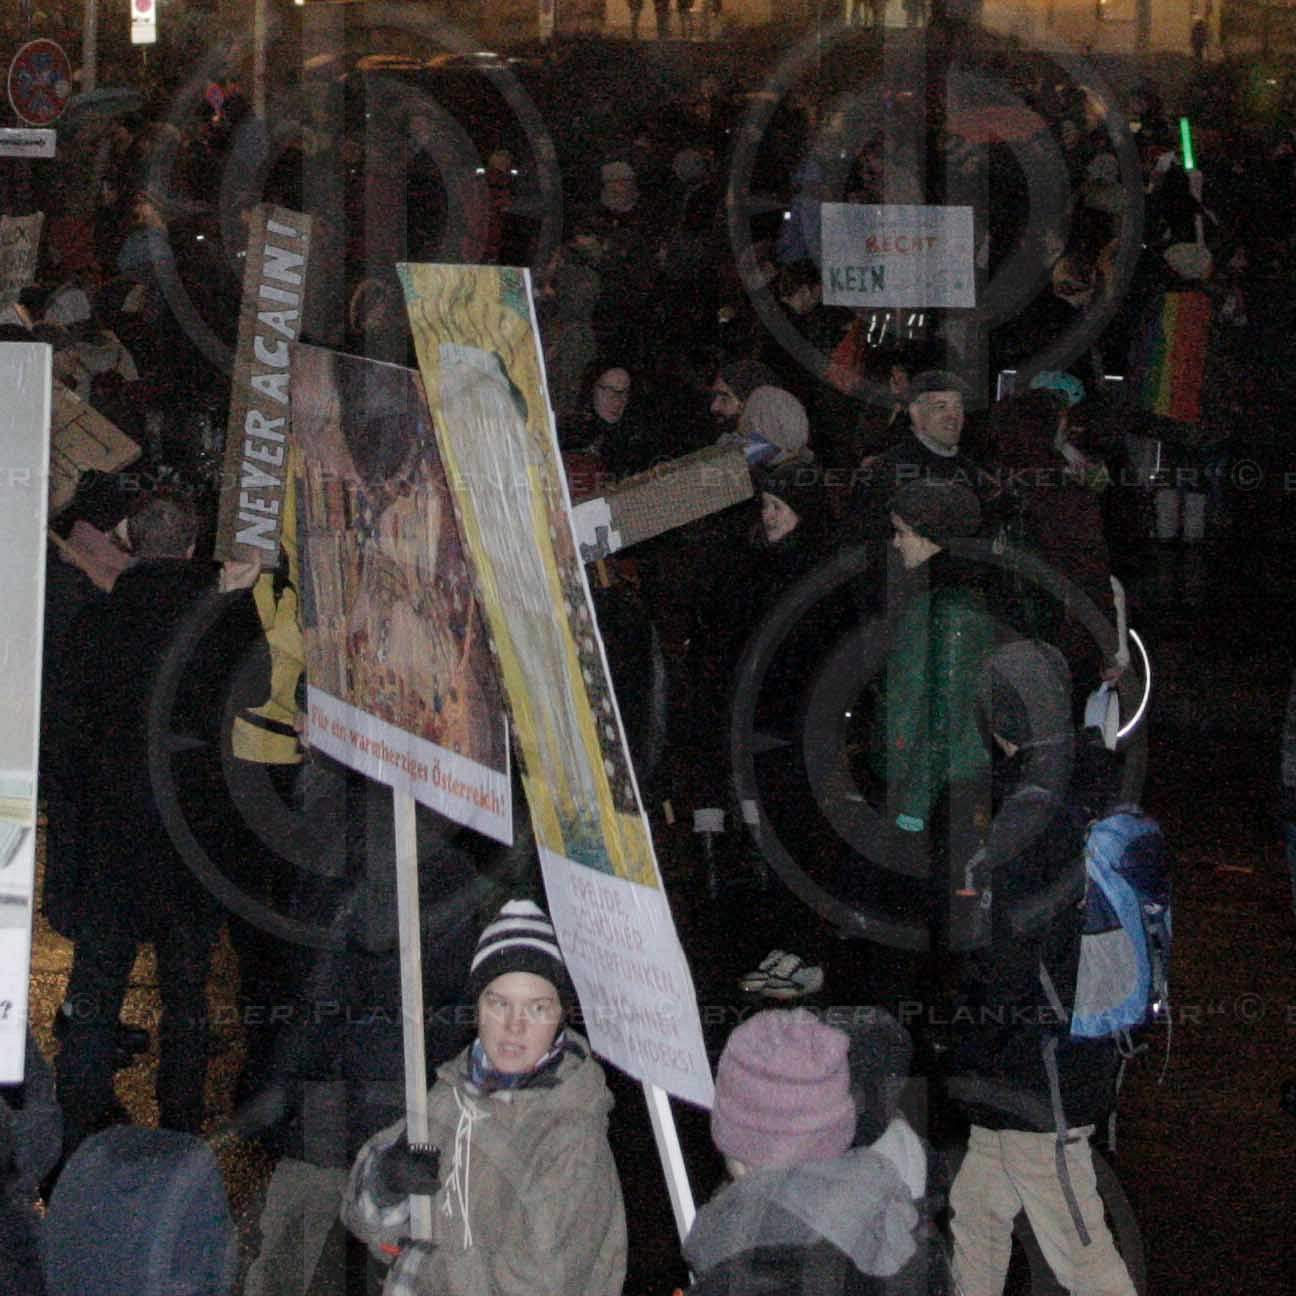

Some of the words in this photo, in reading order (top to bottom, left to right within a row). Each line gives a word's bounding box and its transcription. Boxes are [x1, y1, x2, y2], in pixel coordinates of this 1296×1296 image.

[829, 263, 885, 293] KEIN
[236, 408, 287, 551] NEVER
[331, 721, 346, 737] ein
